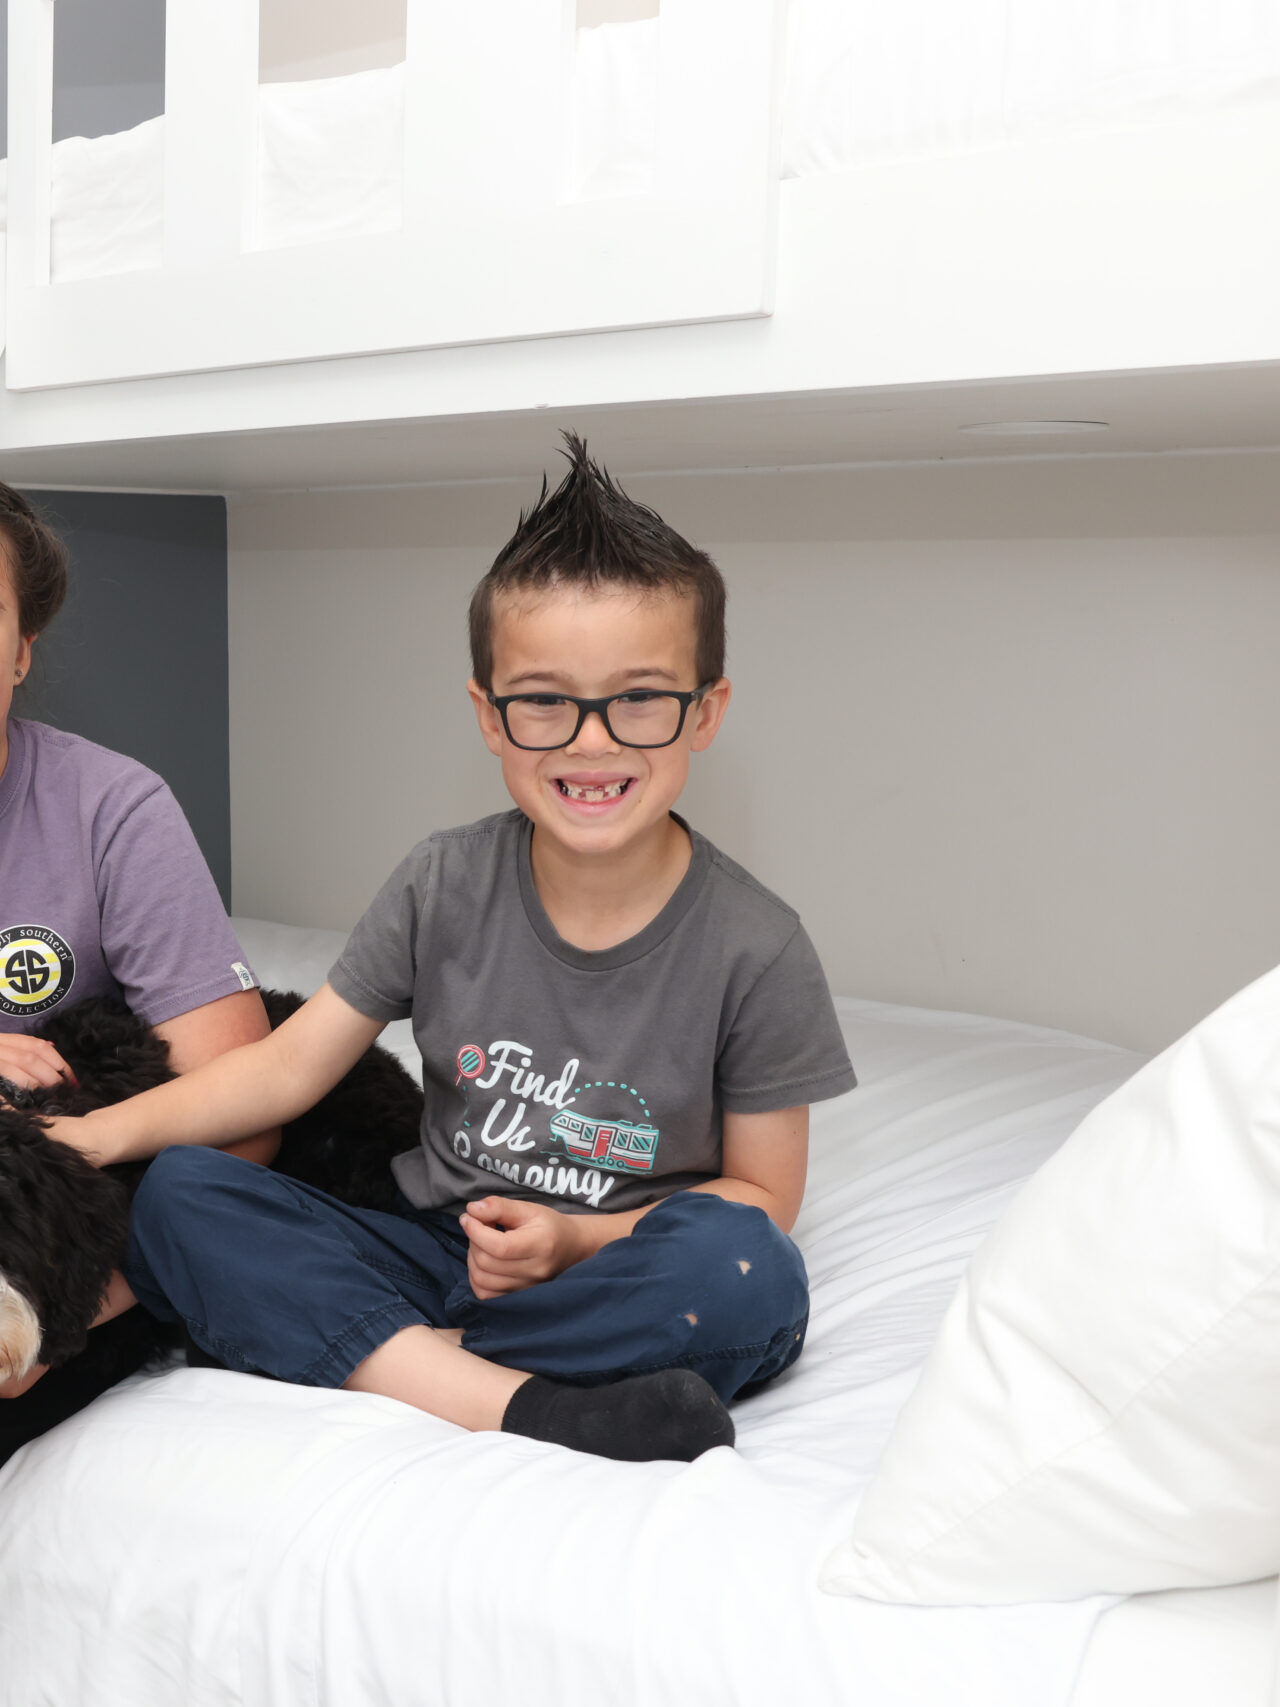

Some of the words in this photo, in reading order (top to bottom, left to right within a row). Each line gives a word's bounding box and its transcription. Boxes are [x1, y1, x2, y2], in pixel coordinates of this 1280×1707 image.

[20, 929, 68, 961] southern
[475, 1040, 580, 1110] Find
[480, 1098, 536, 1152] Us
